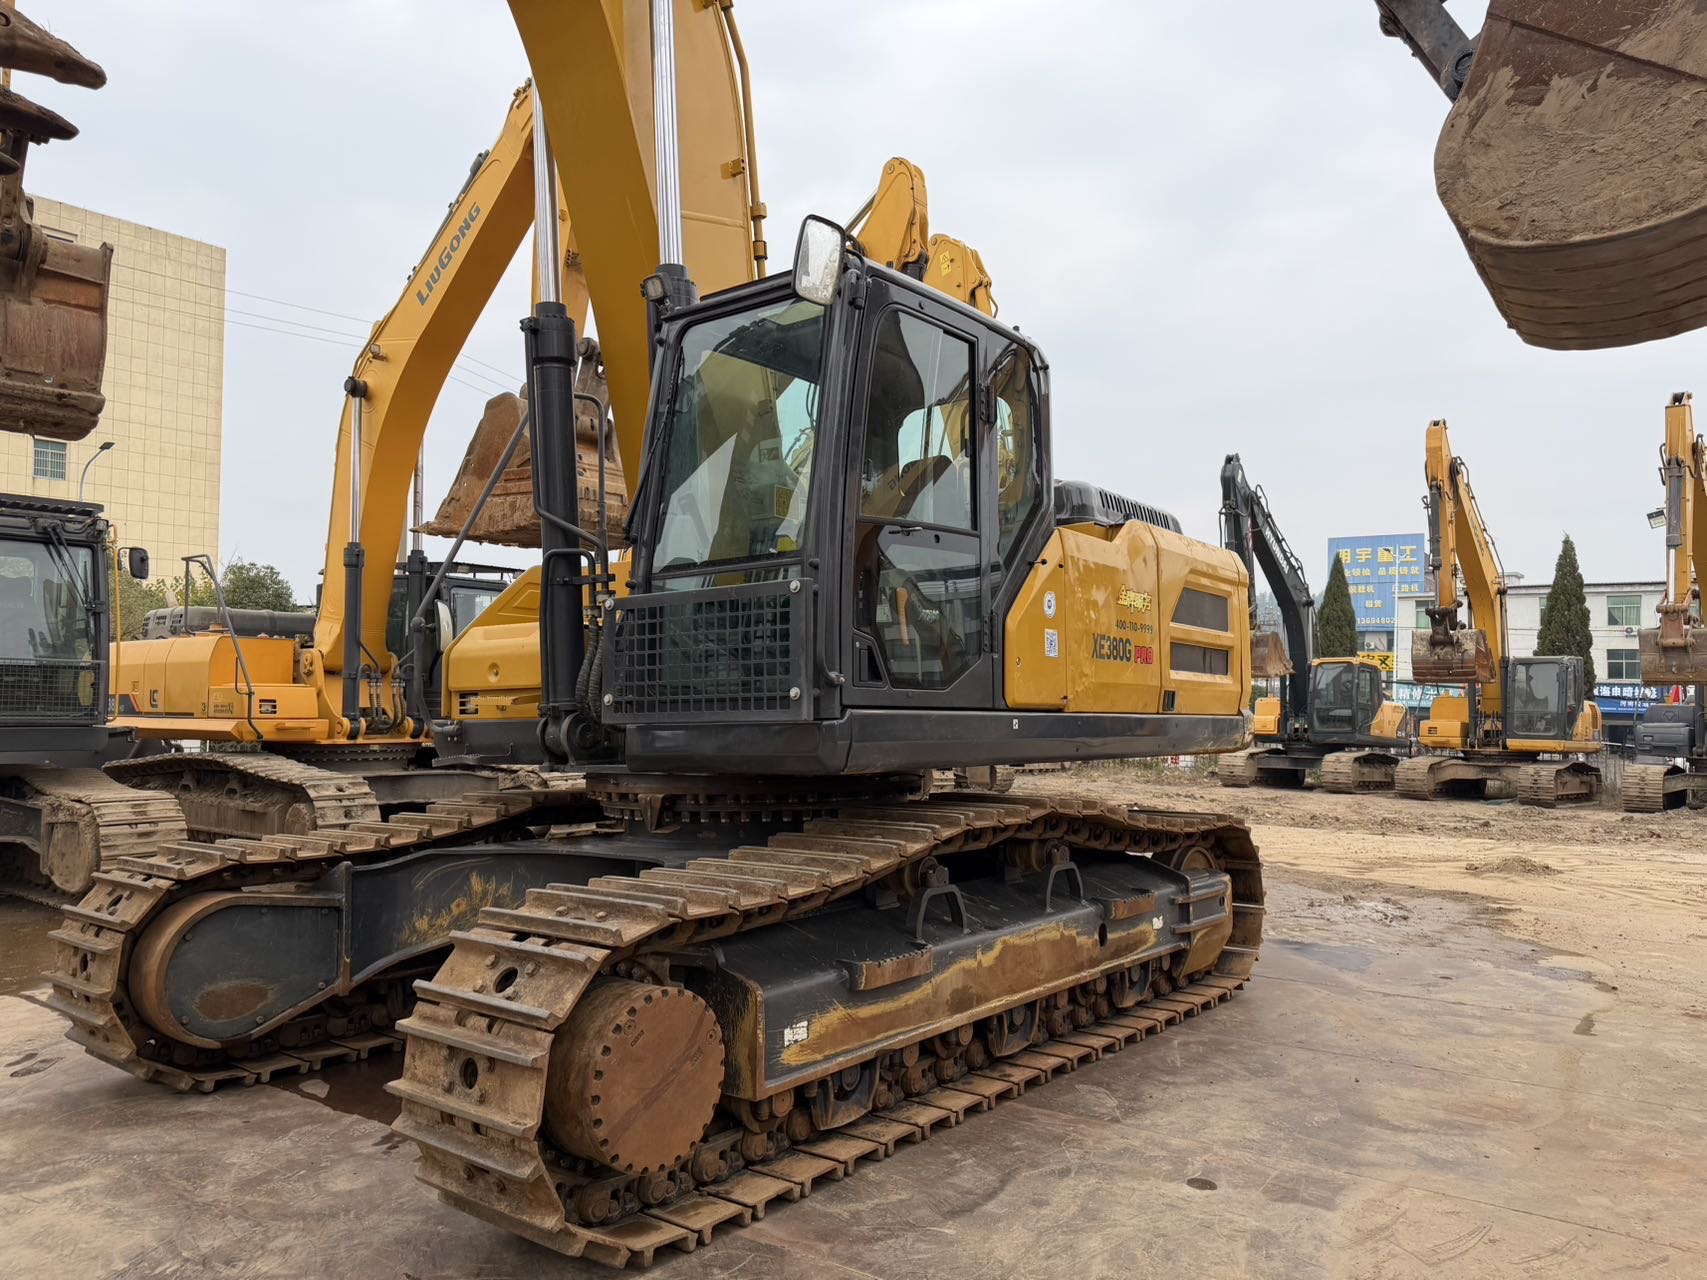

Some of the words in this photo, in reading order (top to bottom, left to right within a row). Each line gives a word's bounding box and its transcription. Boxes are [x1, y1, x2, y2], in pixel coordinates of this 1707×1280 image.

[1265, 526, 1289, 574] HYUNDAI
[1115, 618, 1153, 634] 400-110-9999
[1092, 632, 1132, 662] XE380G
[1134, 645, 1154, 665] PRO
